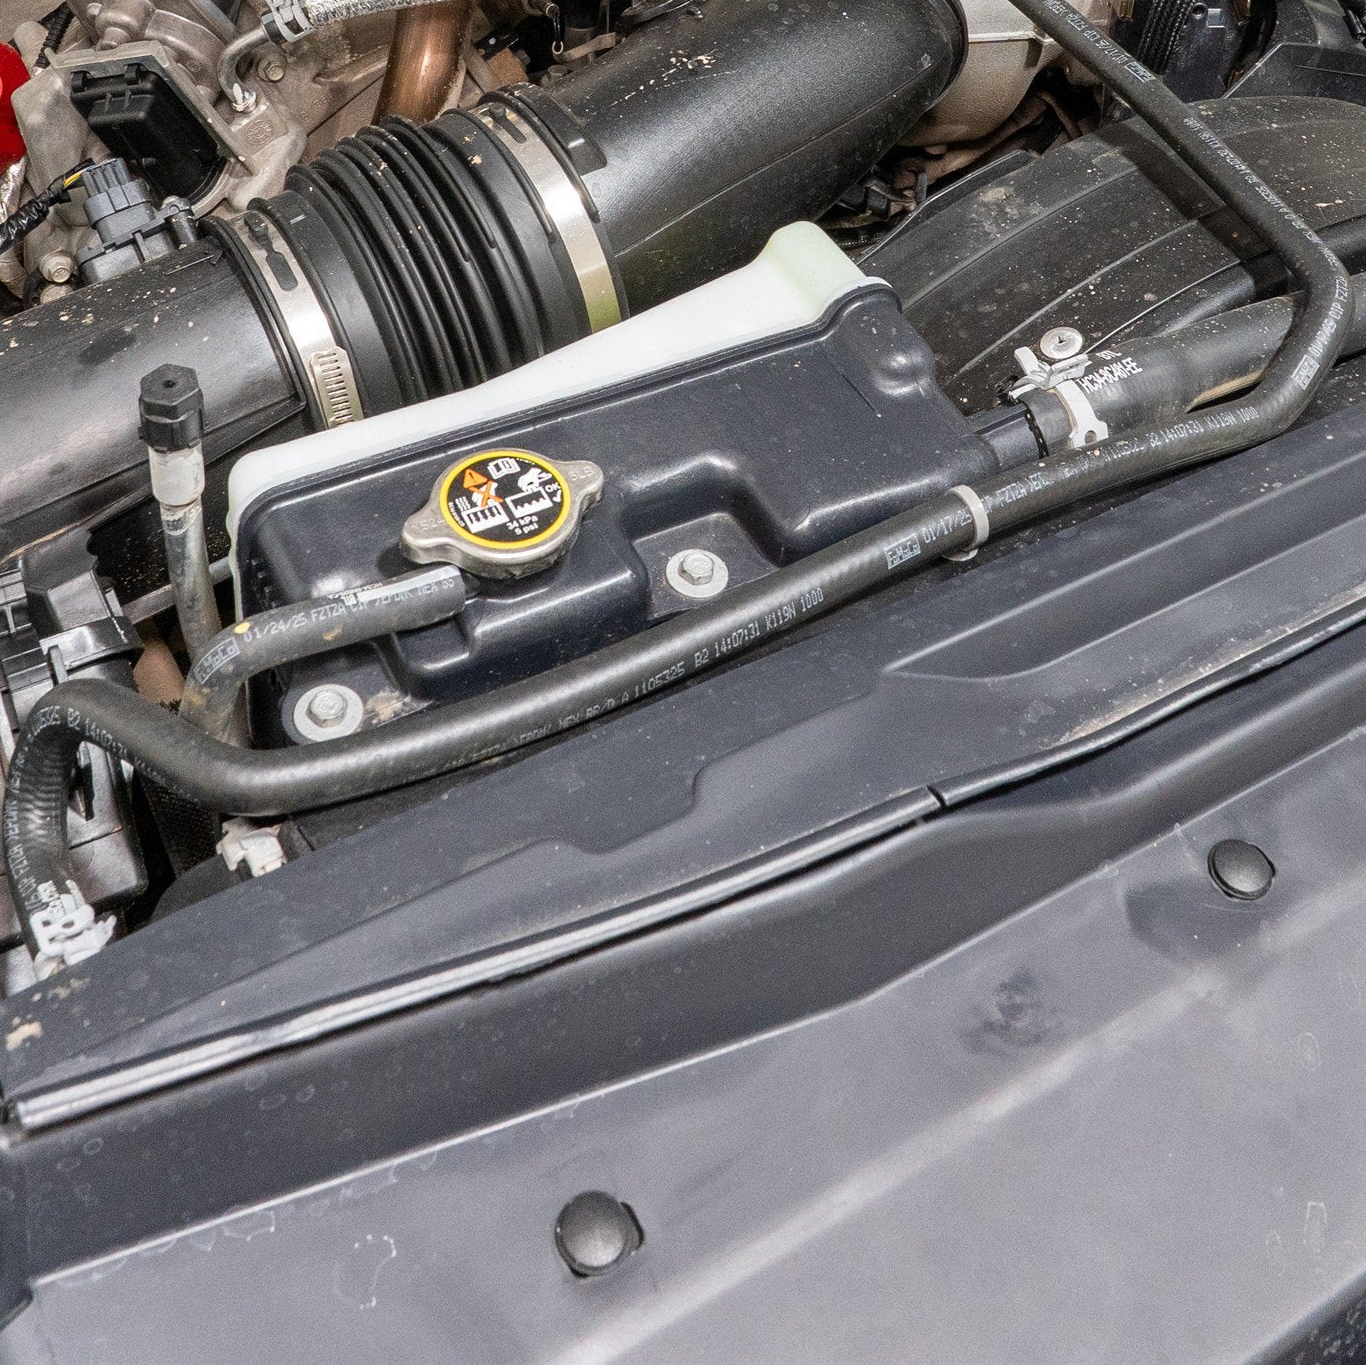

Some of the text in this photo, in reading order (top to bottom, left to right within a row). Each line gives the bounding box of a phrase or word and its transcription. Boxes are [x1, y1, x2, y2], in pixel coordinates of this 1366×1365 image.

[546, 483, 561, 492] OK
[506, 515, 538, 530] 34 kPa
[523, 524, 539, 535] psi
[241, 595, 349, 649] 01/24/25 FZTZA
[630, 661, 689, 697] 1105325
[709, 621, 763, 657] 14:07:31
[761, 602, 799, 631] K119N
[798, 586, 826, 611] 1000
